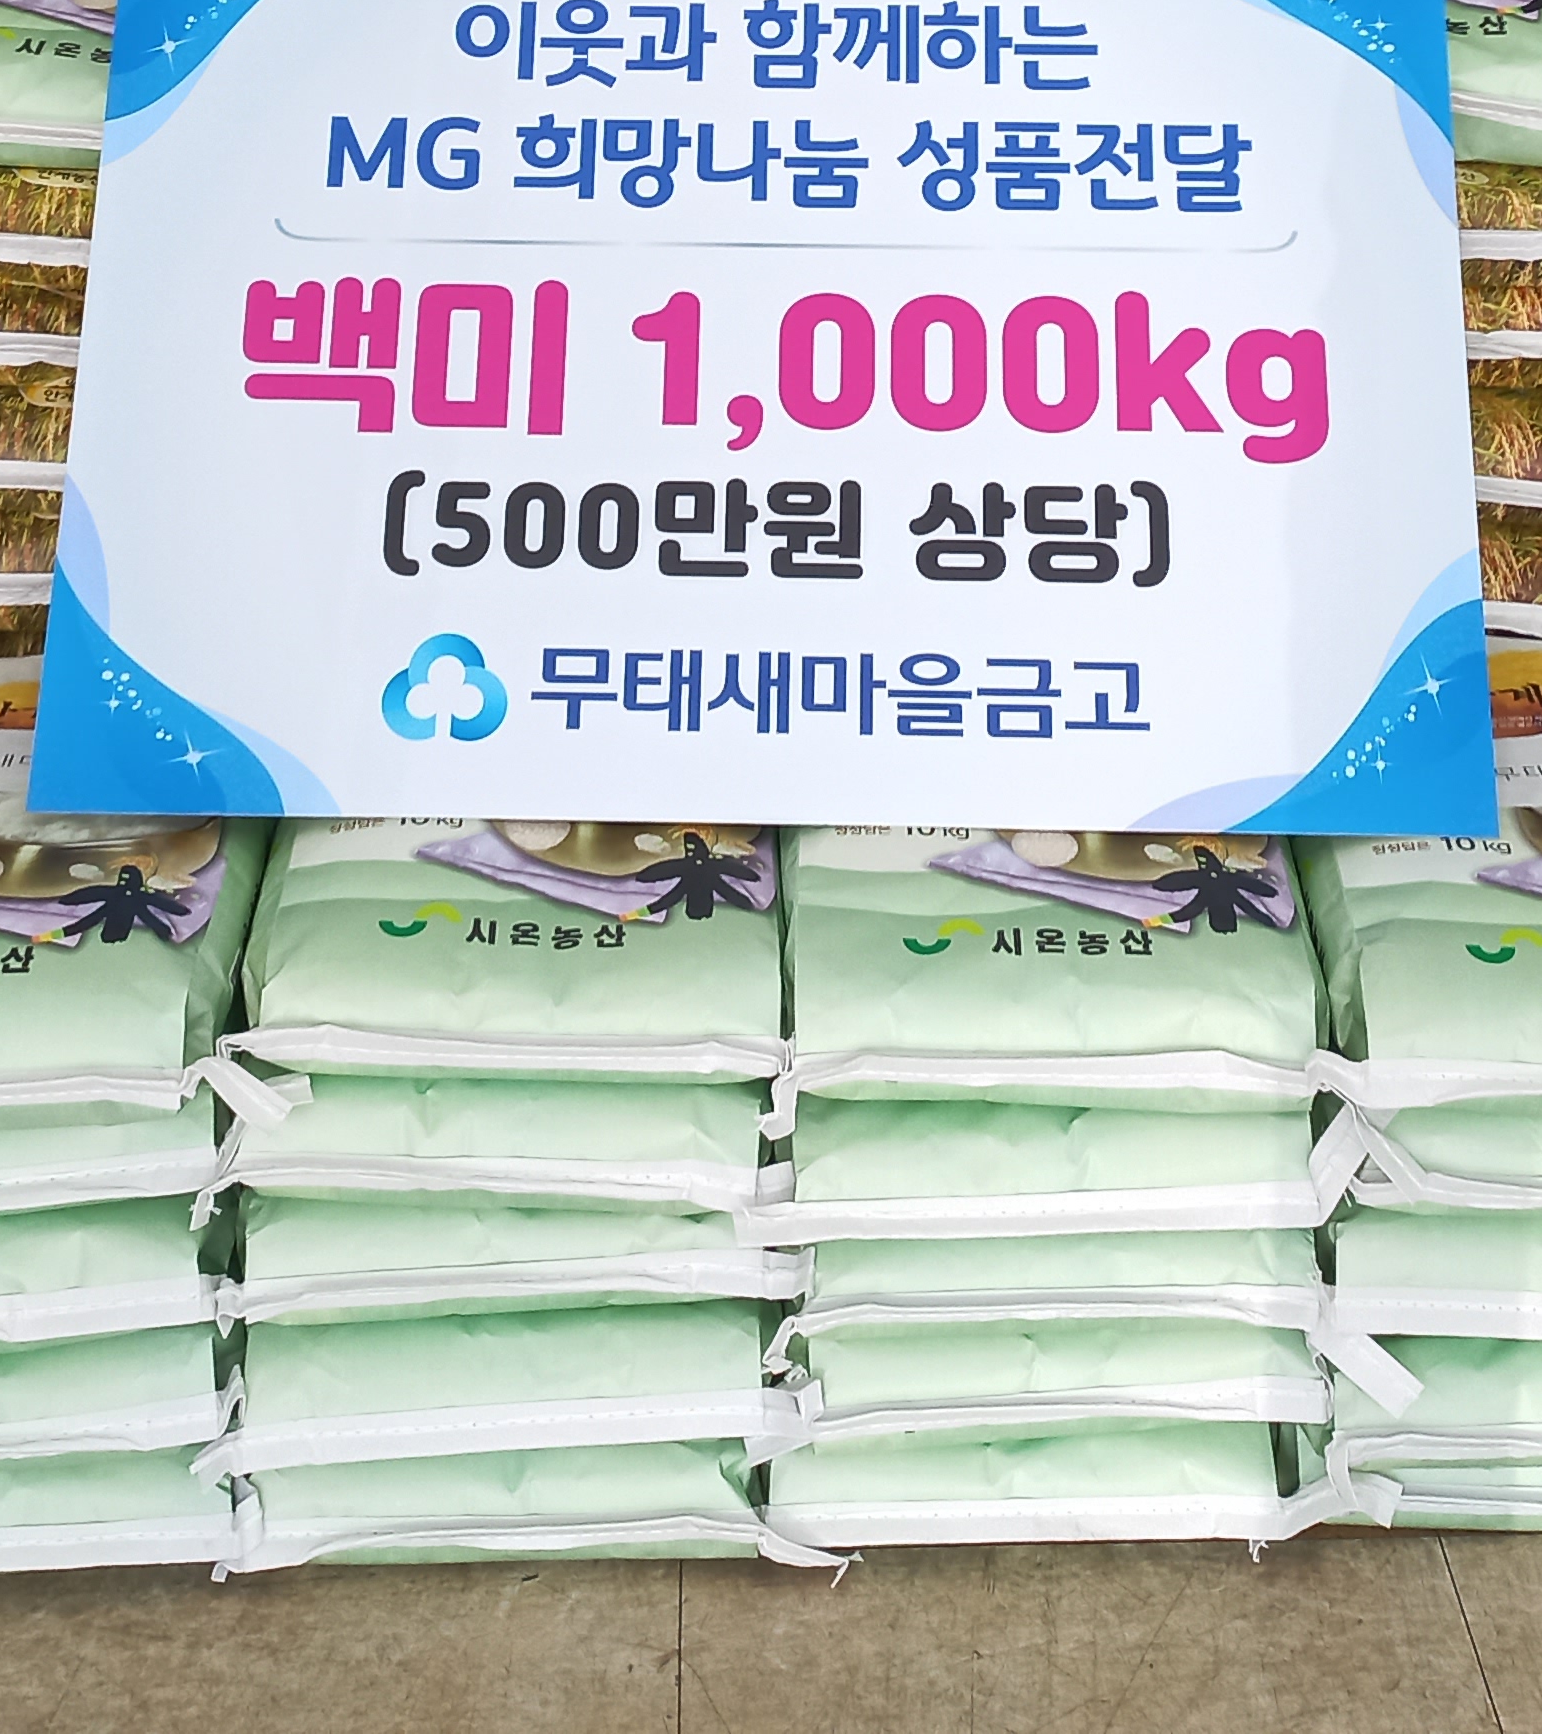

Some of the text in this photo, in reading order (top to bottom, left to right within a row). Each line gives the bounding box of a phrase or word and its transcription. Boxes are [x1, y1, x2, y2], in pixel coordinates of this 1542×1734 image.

[455, 0, 1099, 91] 이웃과 함께하는
[326, 112, 1252, 214] MG 희망나눔 성품전달
[243, 275, 1328, 464] 백미 1,000kg
[383, 469, 1172, 588] (500만원 상당)
[530, 645, 1151, 740] 무태새마을금고
[1440, 836, 1475, 852] 10
[1482, 840, 1512, 855] kg
[466, 918, 626, 949] 시온농산
[992, 927, 1153, 956] 시온농산
